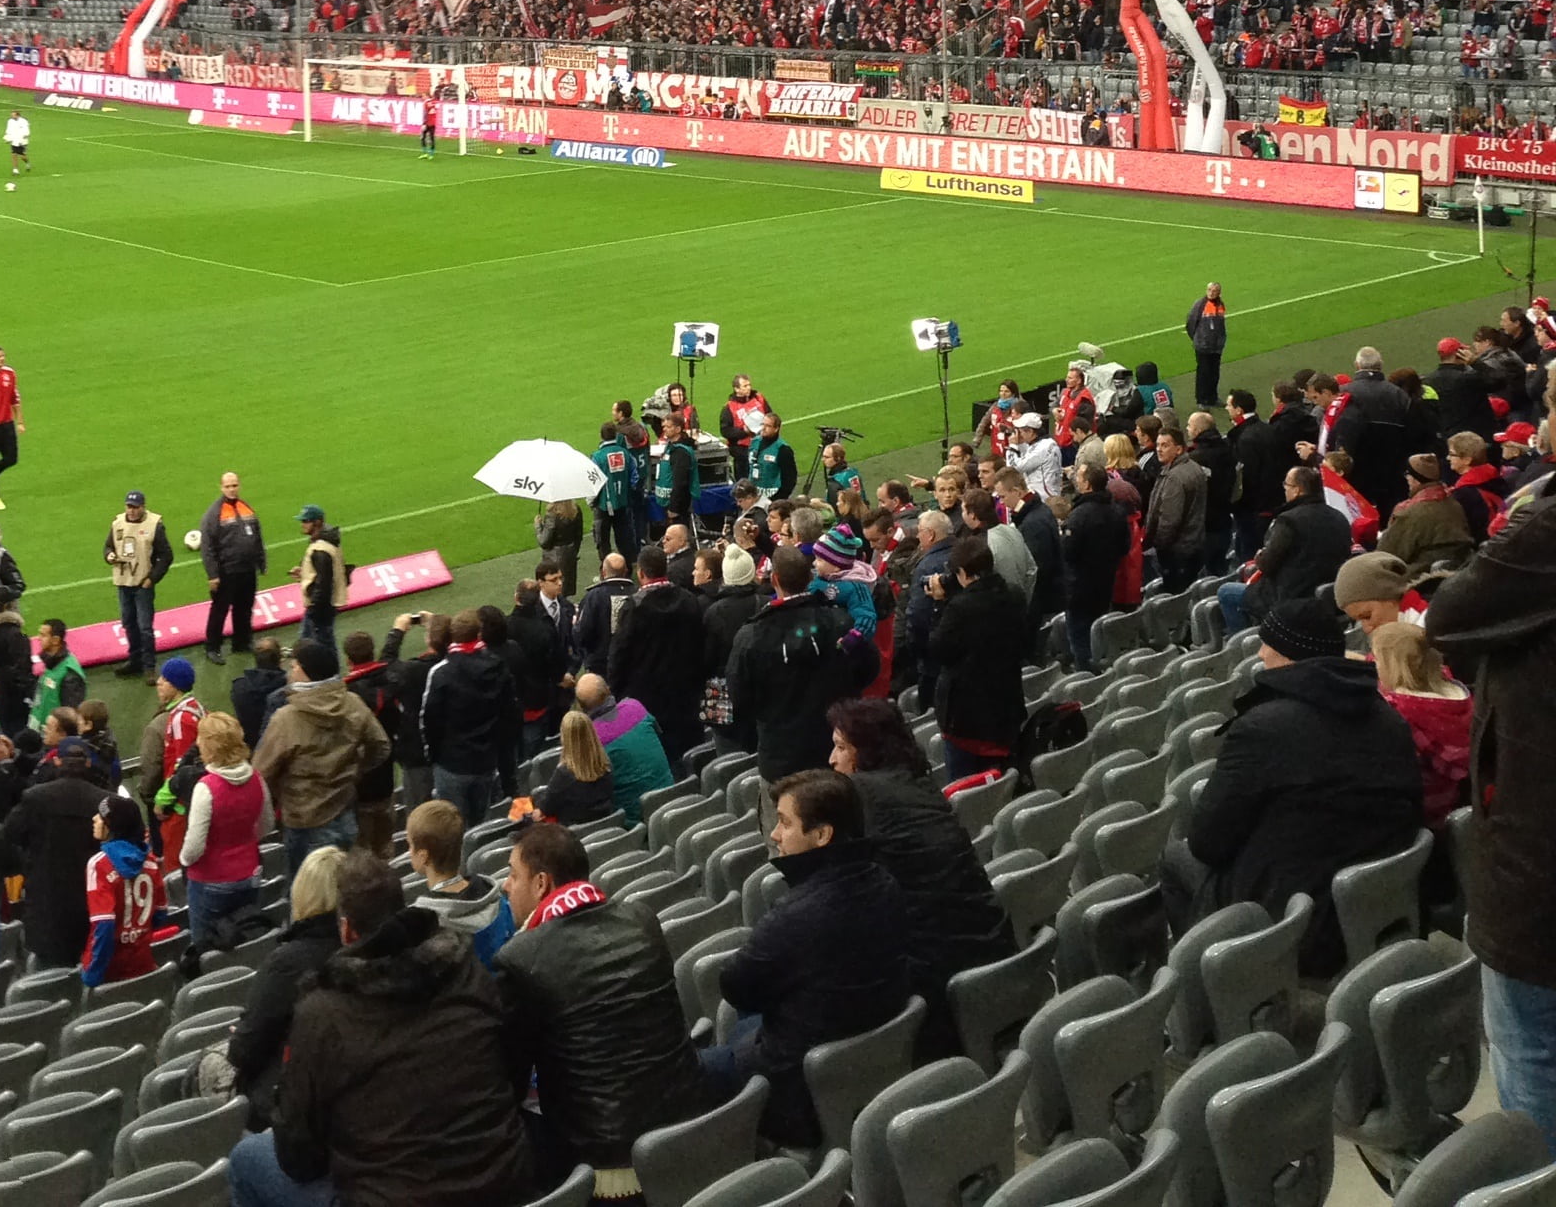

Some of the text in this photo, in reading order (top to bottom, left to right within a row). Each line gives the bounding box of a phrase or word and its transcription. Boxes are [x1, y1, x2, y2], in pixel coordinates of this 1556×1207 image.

[44, 93, 94, 110] bwin
[586, 69, 764, 117] MNCHEN
[780, 84, 856, 102] INFERNO
[858, 106, 916, 128] ADLER
[554, 141, 628, 163] Allianz
[784, 129, 1125, 184] AUF SKY MIT ENTERTAIN.
[1337, 129, 1456, 182] Nord
[1478, 137, 1544, 155] BFC 75
[926, 175, 1023, 197] Lufthansa
[513, 476, 545, 494] sky
[119, 560, 139, 577] TV
[124, 873, 154, 928] 19
